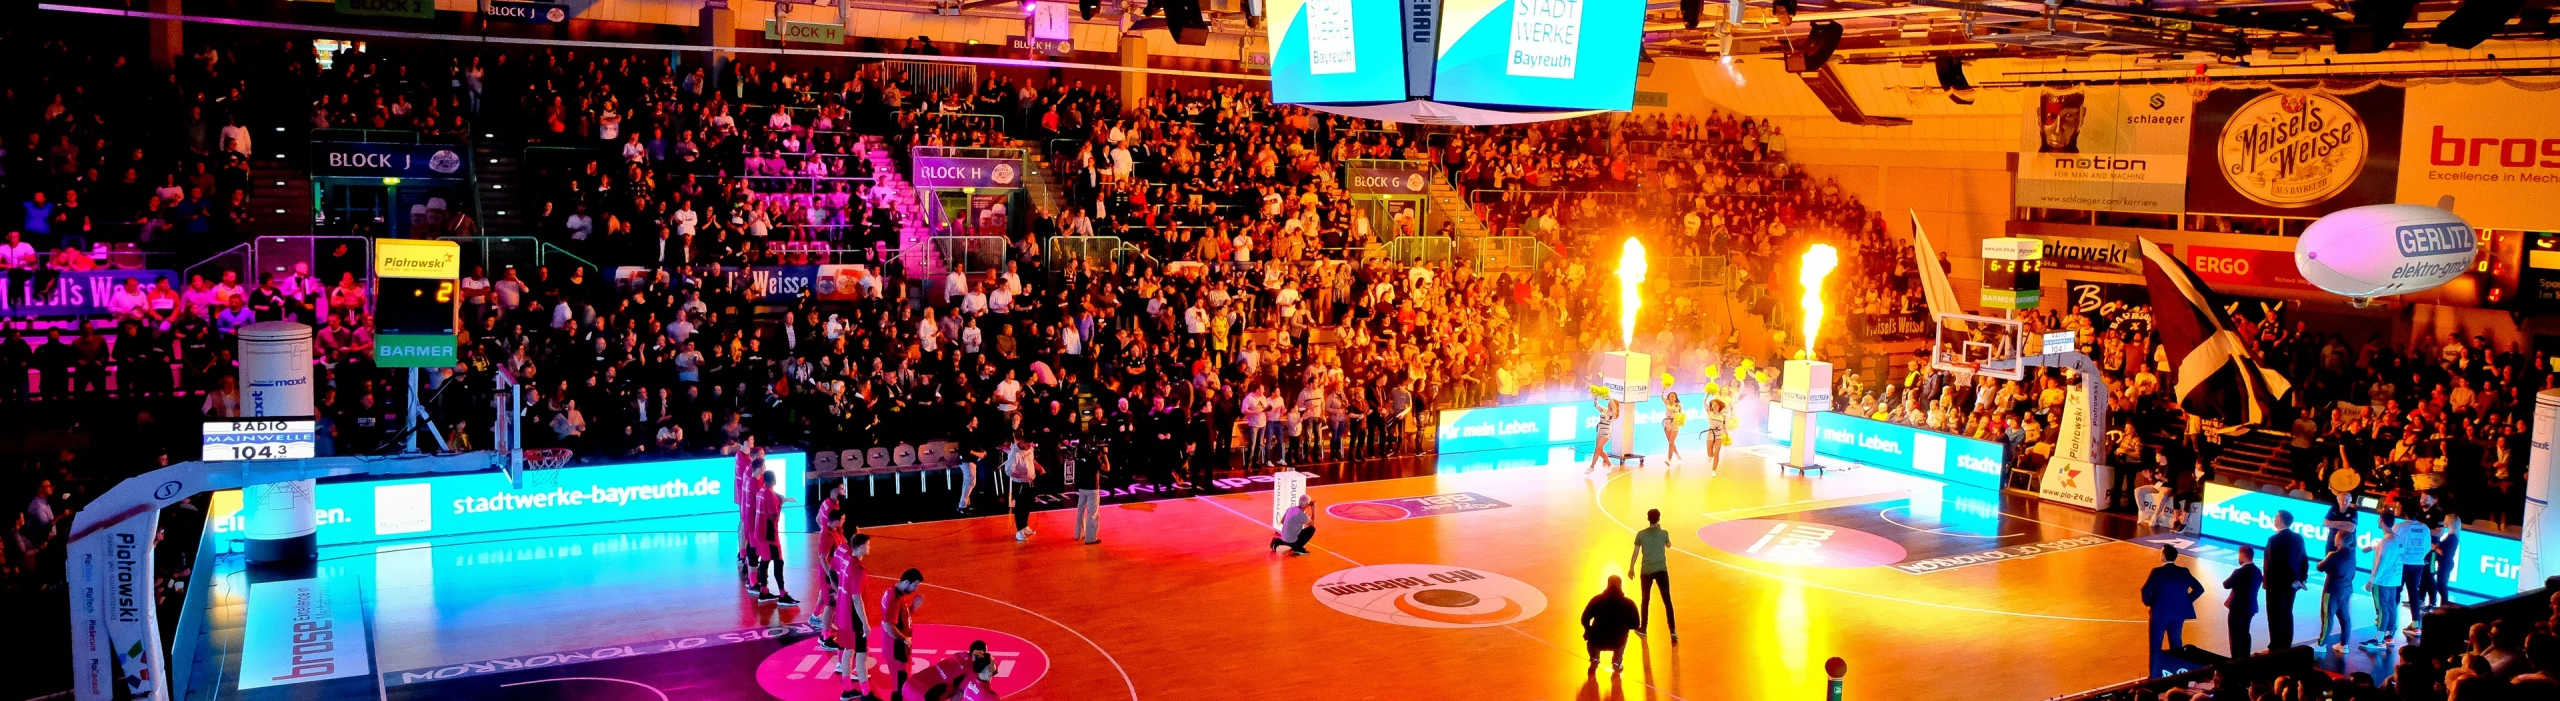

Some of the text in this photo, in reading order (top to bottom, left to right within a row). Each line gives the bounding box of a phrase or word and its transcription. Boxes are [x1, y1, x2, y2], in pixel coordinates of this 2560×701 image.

[487, 6, 535, 19] BLOCK J
[1518, 0, 1578, 19] STADT
[1412, 0, 1432, 43] HAU
[826, 28, 836, 39] H
[1516, 22, 1575, 45] WERKE
[1045, 42, 1052, 50] H
[1513, 50, 1572, 68] Bayreuth
[2127, 114, 2186, 126] schlaeger
[2231, 99, 2324, 175] Maisel's
[2270, 121, 2355, 179] Weisse
[329, 152, 393, 169] BLOCK
[404, 153, 411, 170] J
[2055, 155, 2147, 171] motion
[921, 166, 966, 179] BLOCK
[971, 167, 981, 179] H
[2091, 172, 2107, 180] AND
[2110, 173, 2145, 181] MACHINE
[2428, 170, 2560, 183] Excellence in Mech
[1354, 176, 1388, 188] BLOCK
[1392, 177, 1400, 188] G
[2290, 178, 2328, 195] BAYREUTH
[2399, 225, 2472, 254] GERLITZ
[2042, 240, 2129, 264] otrowski
[383, 257, 445, 269] Piotrowski
[2195, 255, 2250, 276] ERGO
[1982, 294, 2015, 304] BARMER
[380, 345, 453, 357] BARMER
[275, 376, 307, 387] maxit
[252, 390, 264, 417] axit
[232, 421, 288, 432] RADIO
[1498, 419, 1540, 436] Leben.
[2069, 407, 2083, 460] Piotrowski
[206, 433, 312, 443] MAINWELLE
[1823, 428, 1855, 445] mein
[1858, 432, 1903, 455] Leben.
[453, 476, 721, 515] stadtwerke-bayreuth.de
[2042, 488, 2094, 504] www.pio-24.de
[315, 506, 352, 525] en.
[1899, 549, 2020, 574] TOMORROW
[116, 532, 139, 623] Piotrowski
[1322, 575, 1437, 597] Telecom
[88, 619, 98, 652] PioSecure
[271, 619, 335, 681] brose
[400, 622, 823, 684] ROES OF TOMORROW
